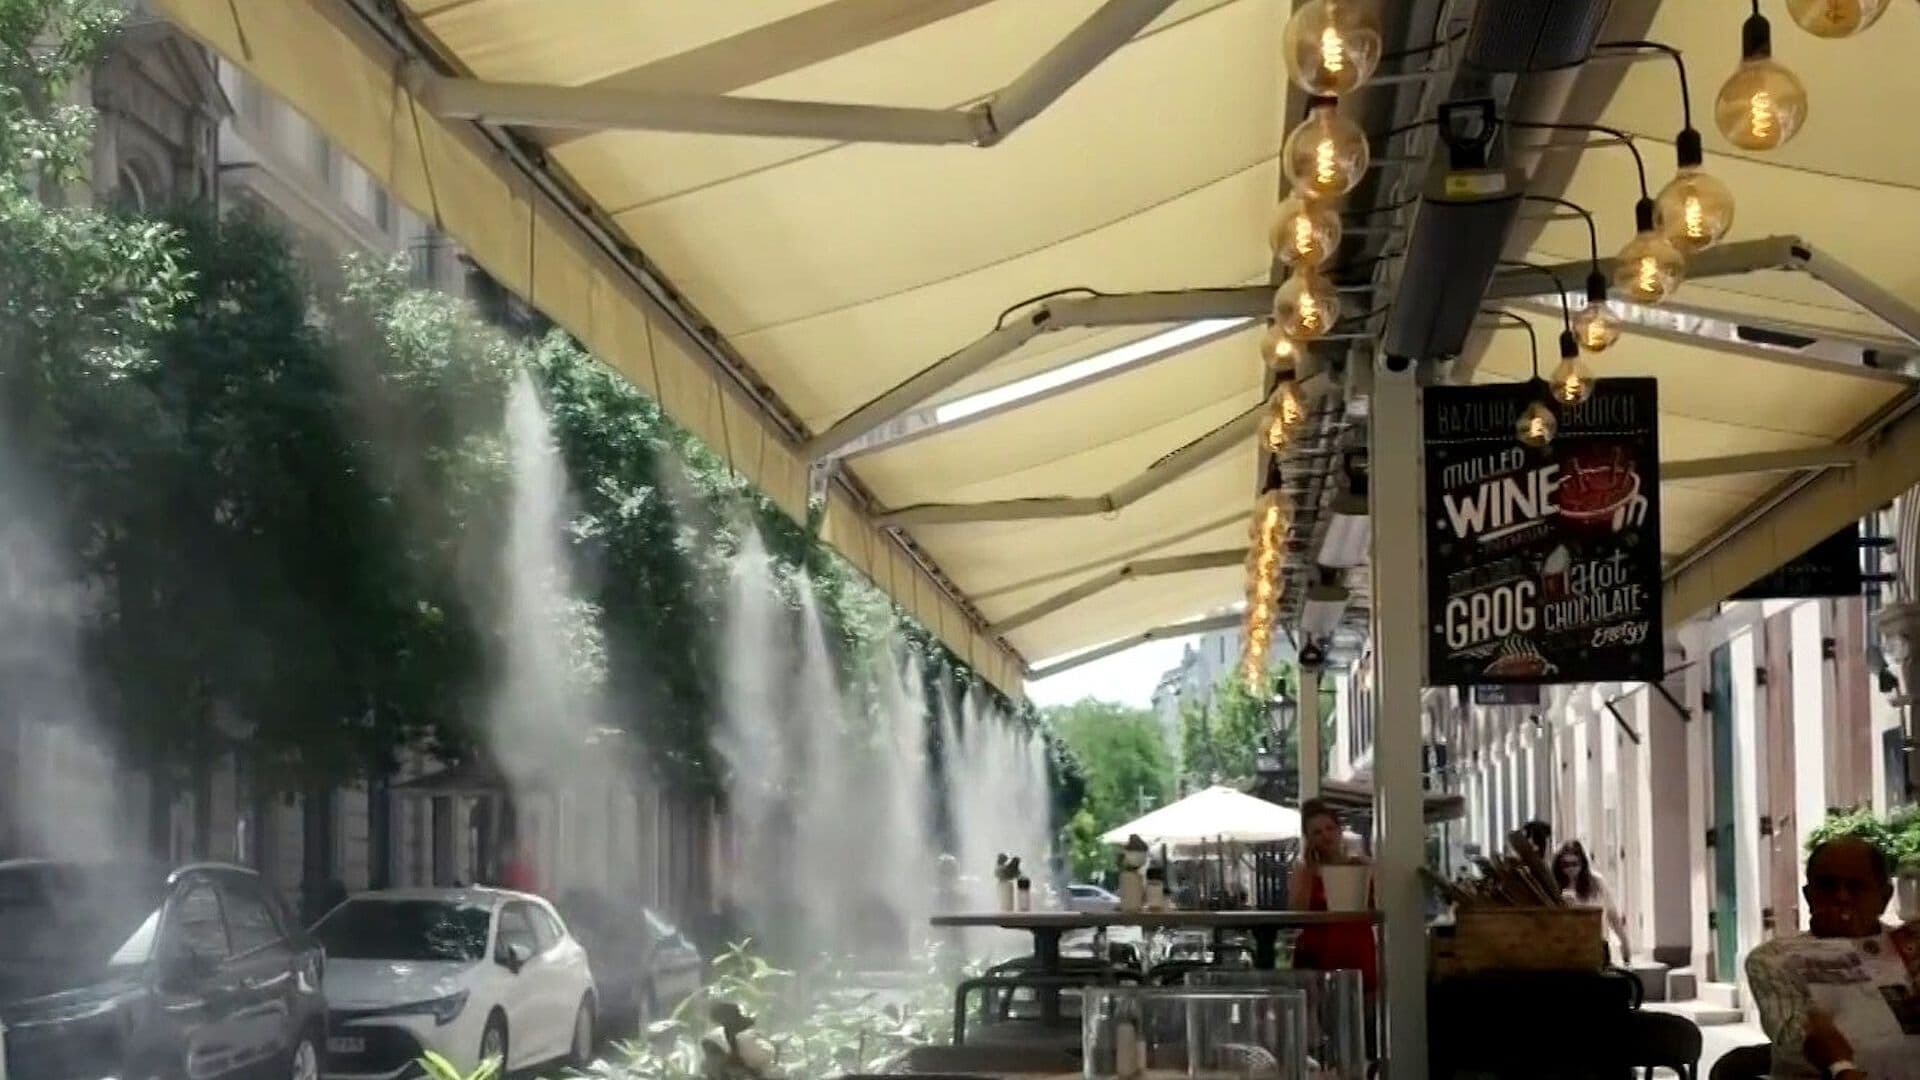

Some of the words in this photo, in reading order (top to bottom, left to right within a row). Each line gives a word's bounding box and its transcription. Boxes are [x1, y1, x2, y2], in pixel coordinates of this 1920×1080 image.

[1442, 446, 1526, 489] MULLED
[1442, 463, 1560, 539] WINE
[1445, 580, 1537, 651] GROG
[1543, 584, 1642, 631] CHOCOLATE
